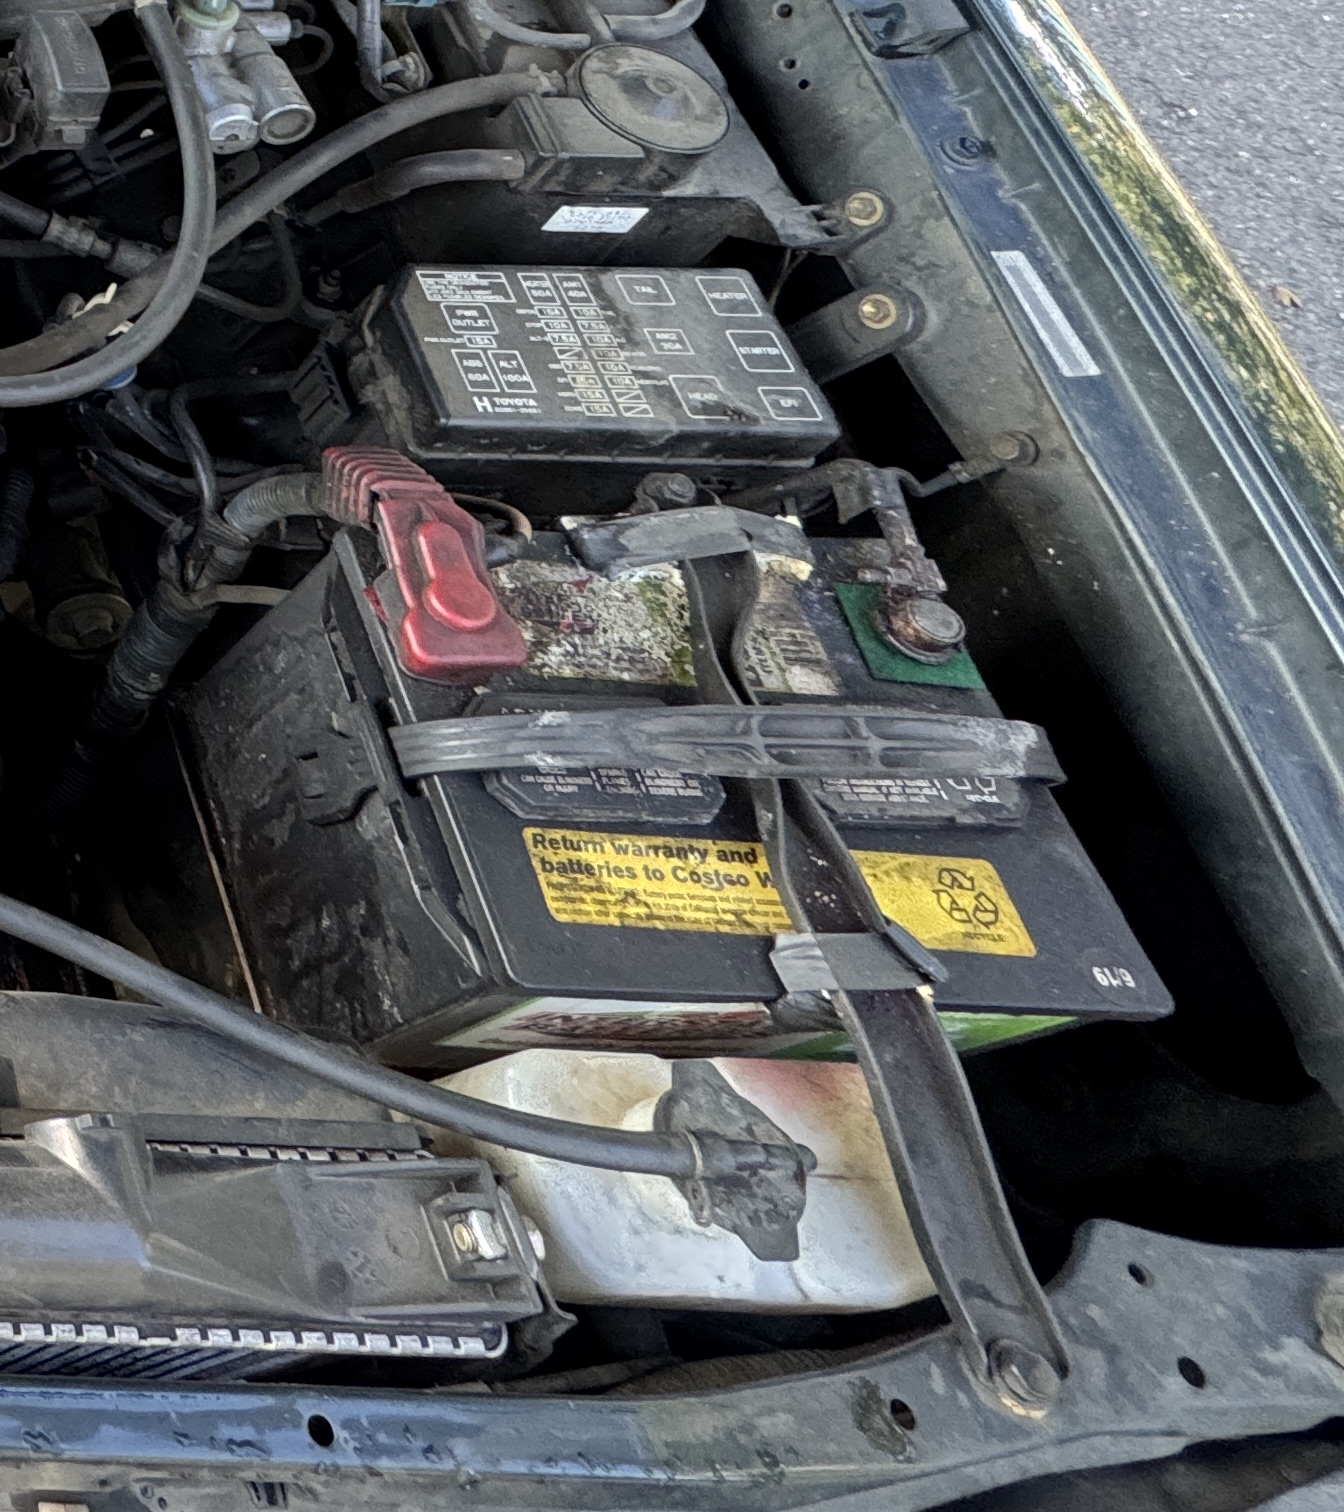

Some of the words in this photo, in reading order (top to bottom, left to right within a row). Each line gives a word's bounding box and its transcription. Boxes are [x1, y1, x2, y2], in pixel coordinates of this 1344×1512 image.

[708, 292, 749, 301] HEATER
[452, 319, 491, 327] OUTLET
[739, 346, 781, 355] STARTER
[499, 360, 518, 368] ALT
[688, 391, 718, 400] HEAD
[473, 396, 494, 412] H
[493, 398, 538, 406] TOYOTA
[531, 832, 605, 855] Return
[611, 838, 708, 864] warranty
[716, 847, 759, 865] and
[540, 856, 638, 881] batteries
[642, 864, 666, 882] to
[670, 863, 750, 889] Costco
